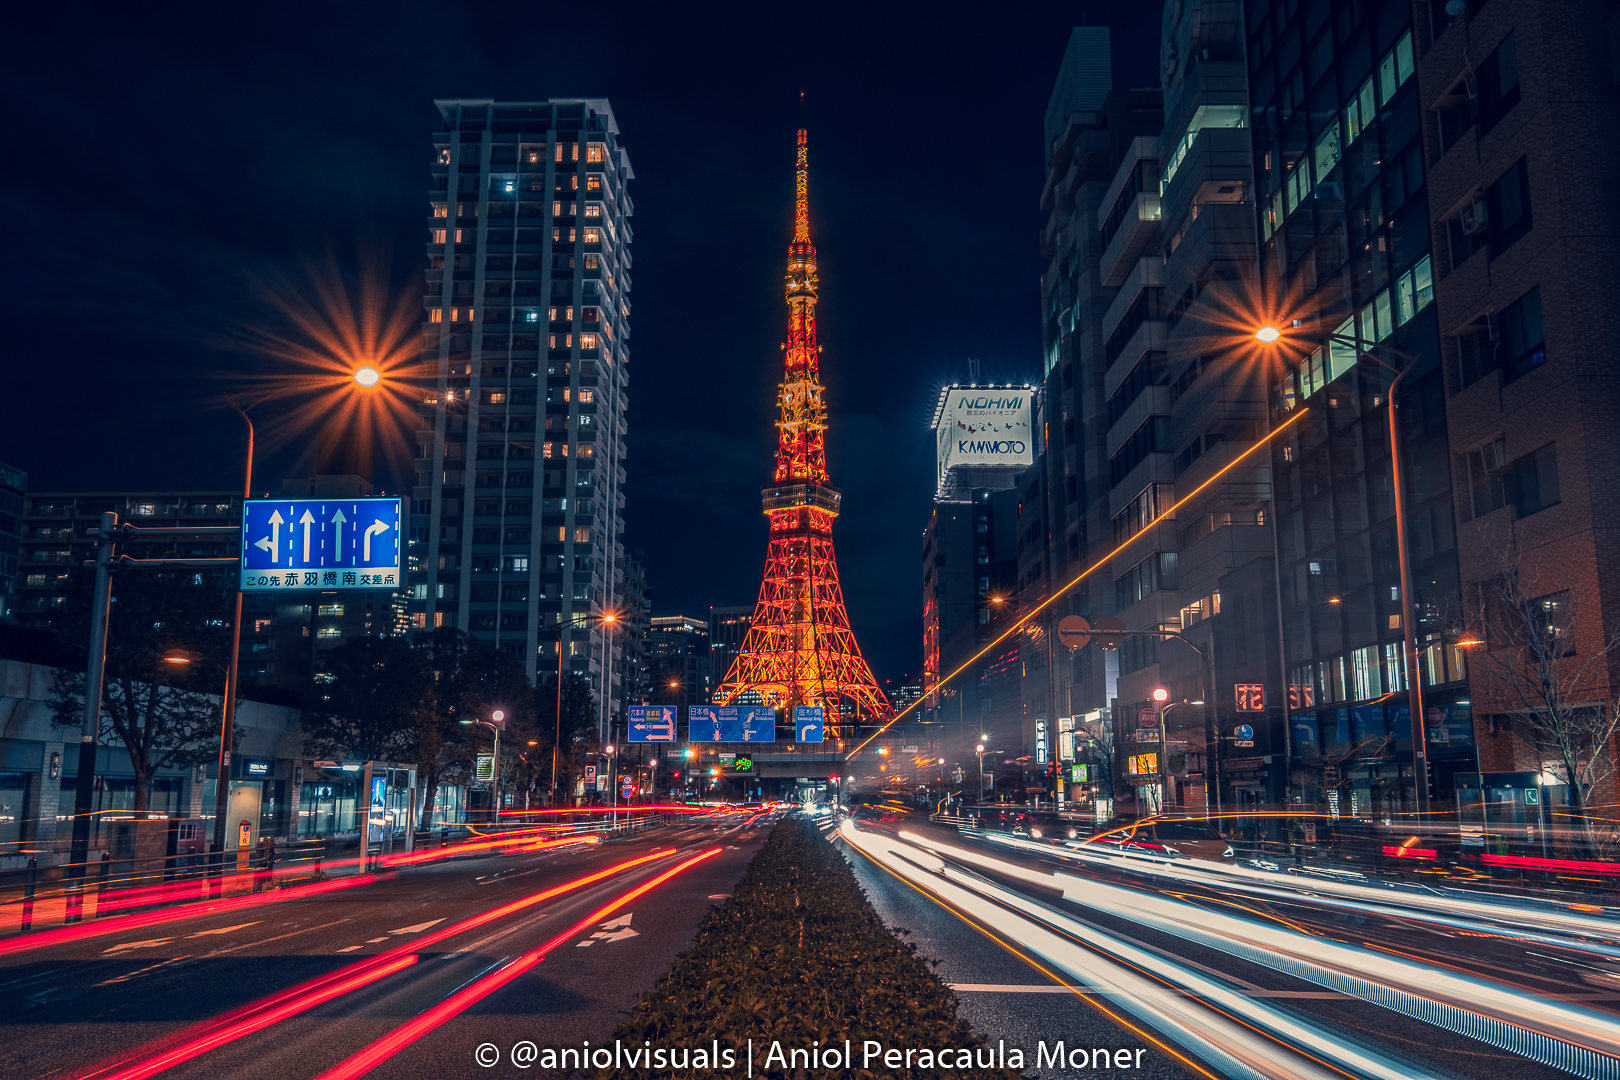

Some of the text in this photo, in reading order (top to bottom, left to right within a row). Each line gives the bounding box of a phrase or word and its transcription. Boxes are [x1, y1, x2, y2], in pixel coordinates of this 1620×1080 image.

[958, 397, 1023, 409] NOHMI
[1238, 685, 1263, 710] 花
[690, 707, 709, 715] 日本橋
[718, 707, 738, 715] 桜田門
[755, 707, 774, 716] 芝公園
[798, 708, 821, 716] 金杉橋
[587, 767, 594, 776] P
